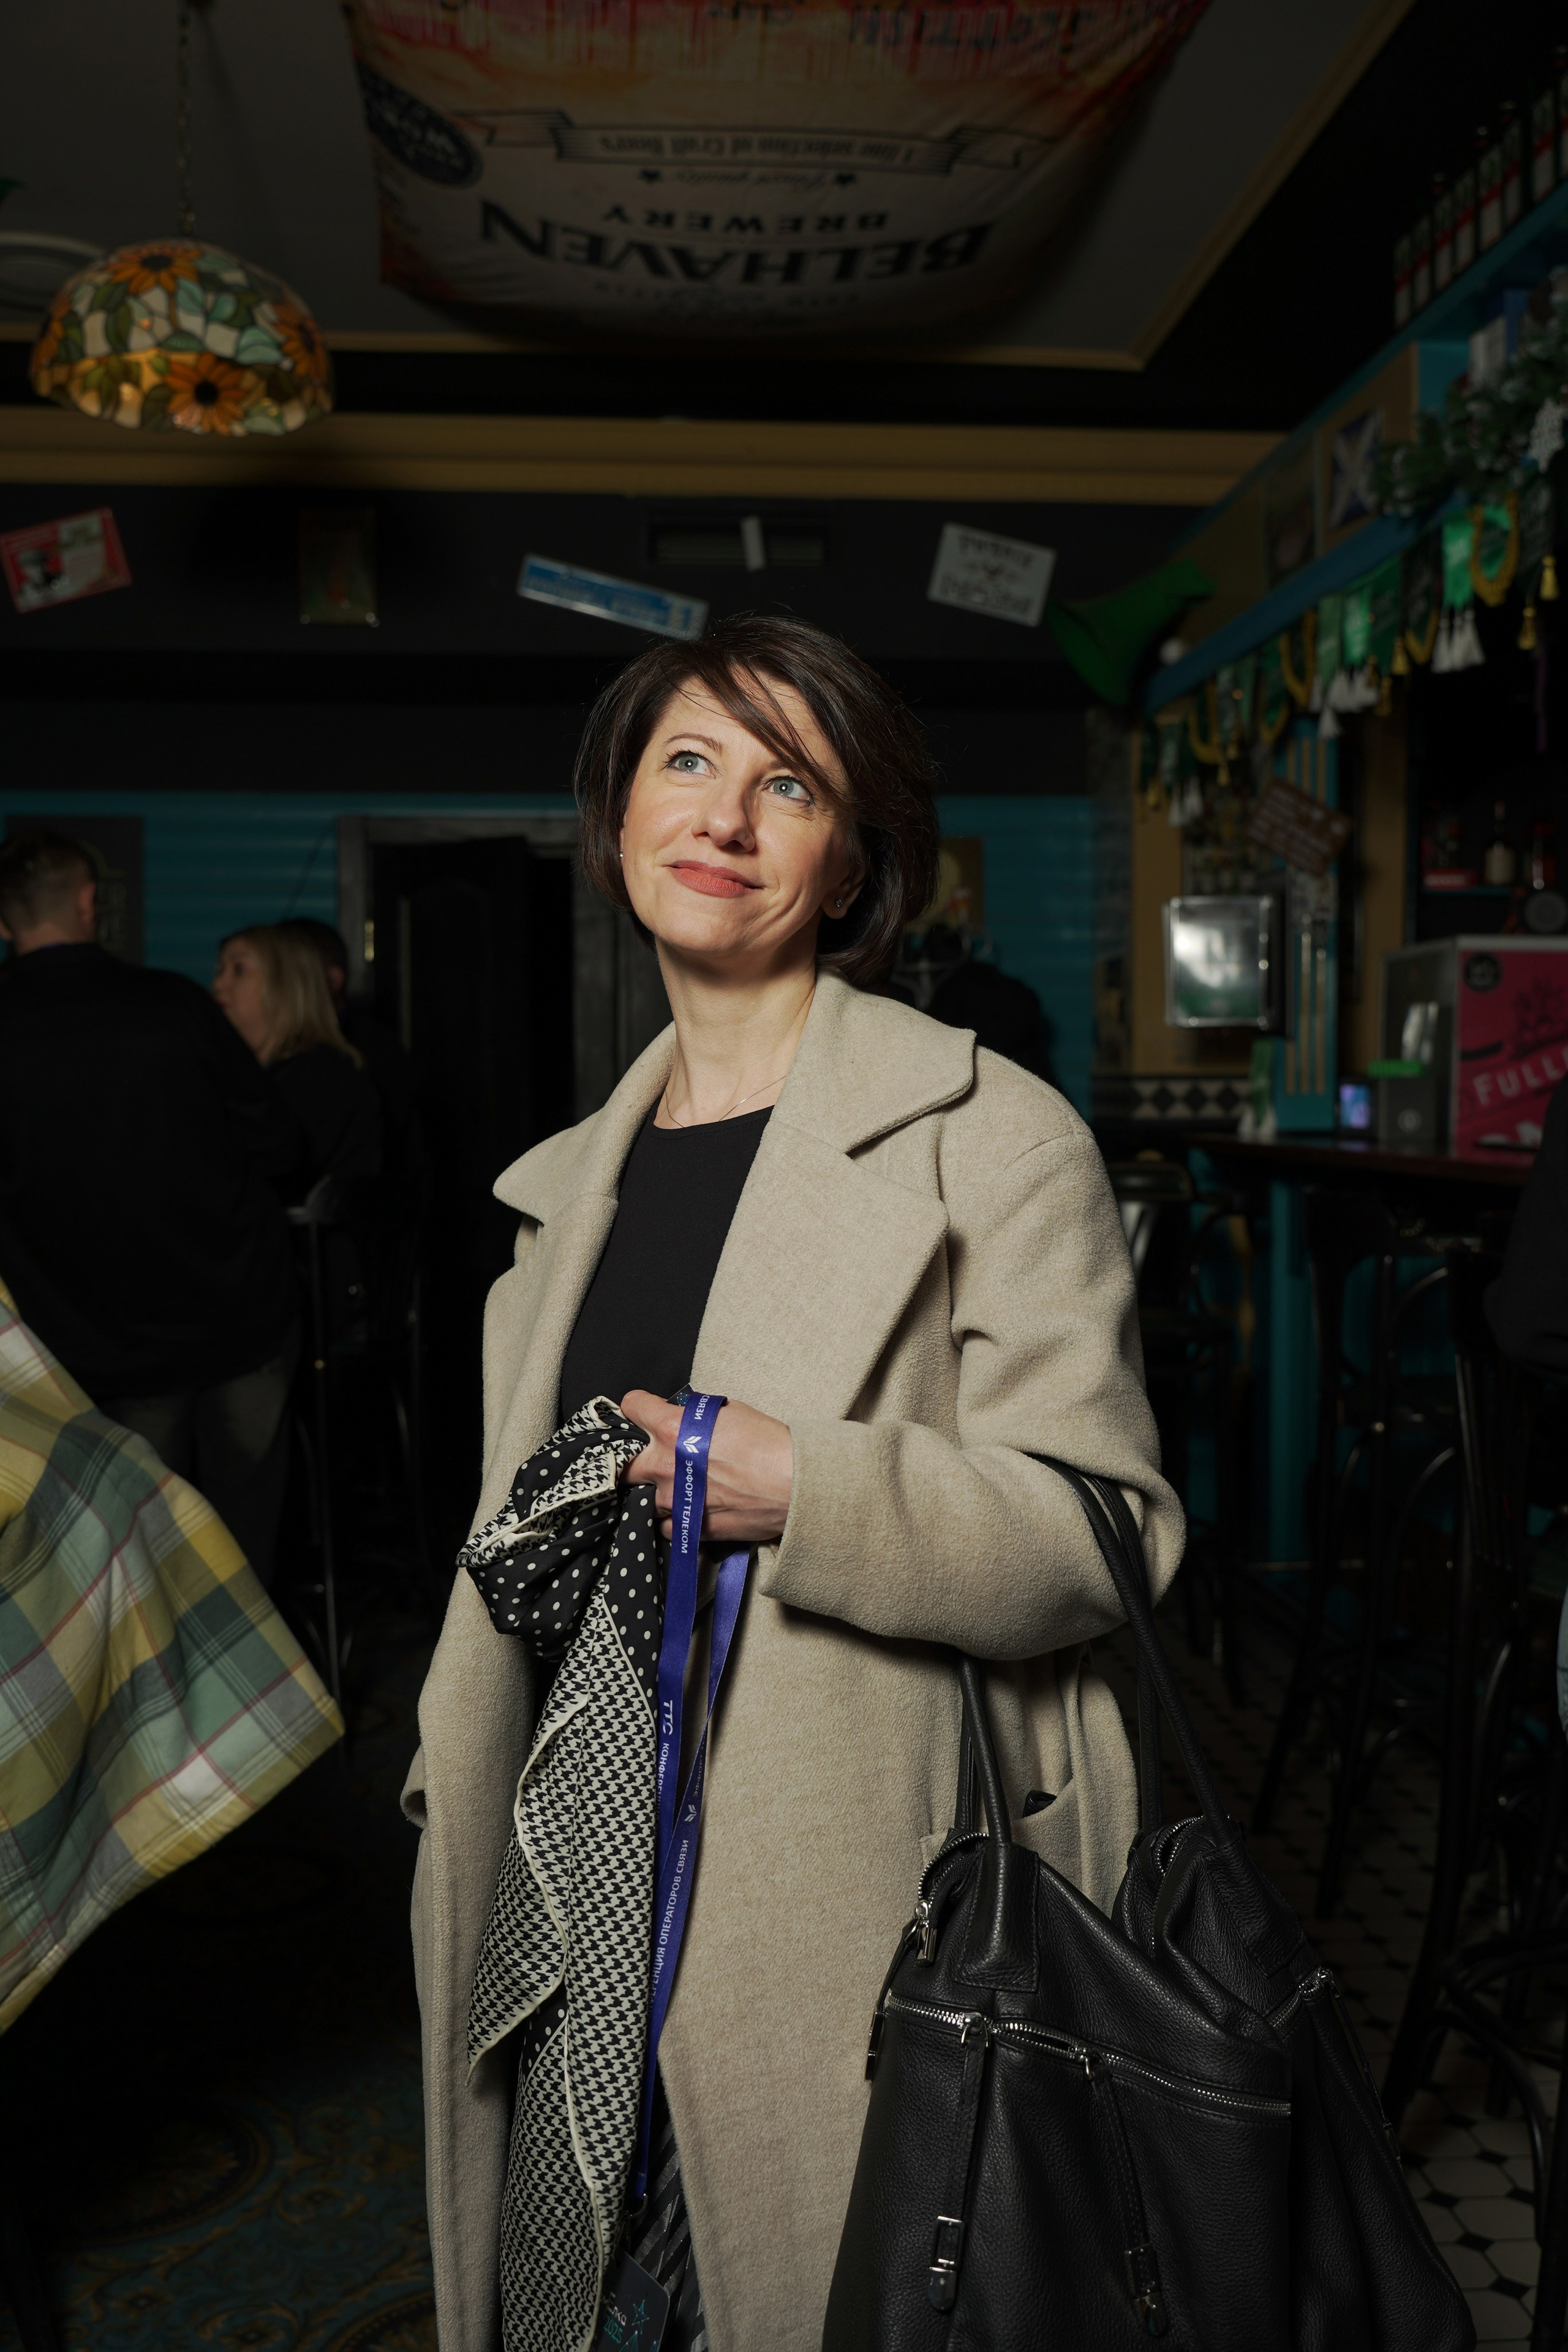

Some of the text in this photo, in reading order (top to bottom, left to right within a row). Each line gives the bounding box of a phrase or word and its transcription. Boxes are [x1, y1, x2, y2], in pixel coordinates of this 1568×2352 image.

[760, 138, 854, 160] selection
[603, 205, 888, 236] BREWERY
[478, 199, 993, 285] BELHAVEN
[694, 1395, 710, 1420] СВЯЗИ
[681, 1460, 693, 1553] ЭФФОРТ ТЕЛЕКОМ
[659, 1876, 682, 1944] ОПЕРАТОРОВ
[676, 1839, 689, 1873] СВЯЗИ
[603, 2314, 623, 2343] 2025
